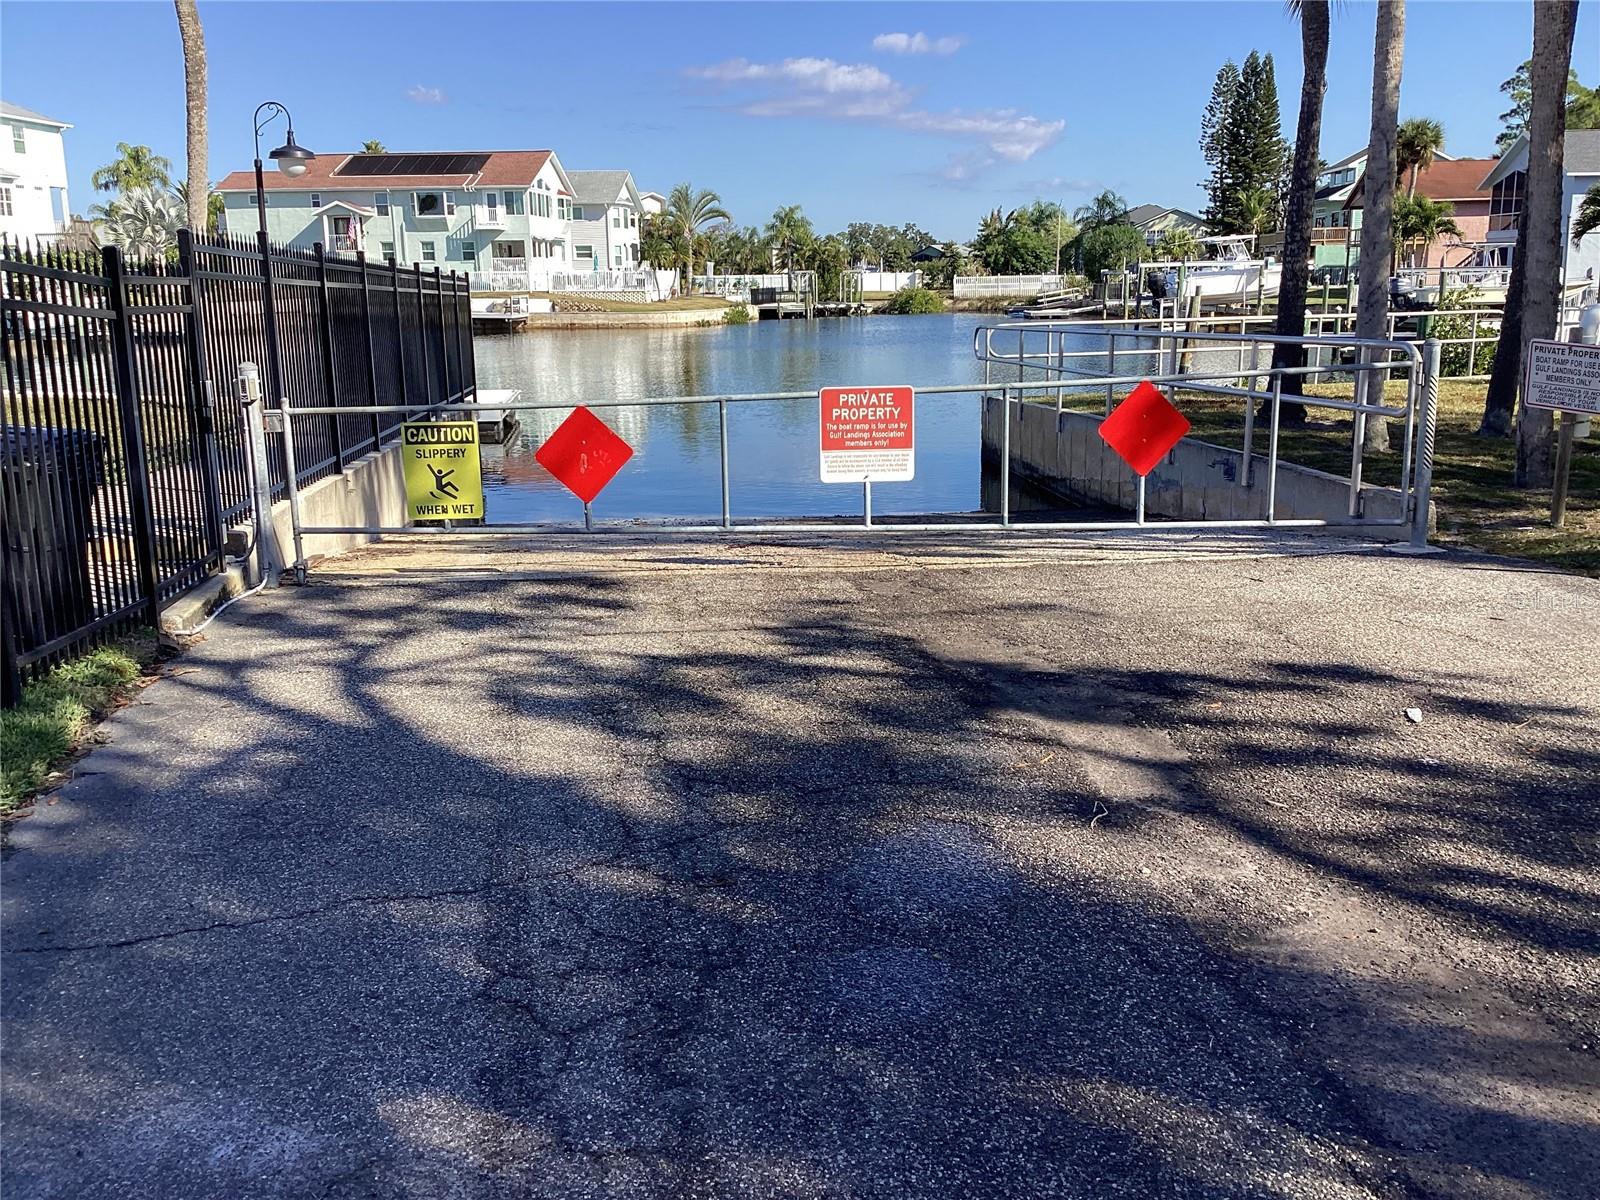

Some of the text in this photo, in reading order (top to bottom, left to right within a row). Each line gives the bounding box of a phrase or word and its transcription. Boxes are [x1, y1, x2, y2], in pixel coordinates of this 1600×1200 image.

[1535, 346, 1600, 360] PRIVATE PROPER
[1535, 356, 1551, 364] BOAT
[1570, 360, 1583, 368] FOR
[1584, 362, 1596, 370] USE
[1535, 364, 1600, 378] GULF LANDINGS ASSO
[1546, 375, 1592, 386] MEMBERS ONLY
[1538, 389, 1582, 398] RESPONSIBLE
[1549, 385, 1582, 394] LANDINGS
[839, 392, 894, 406] PRIVATE
[832, 407, 901, 420] PROPERTY
[900, 422, 908, 430] by
[407, 428, 473, 442] CAUTION
[843, 432, 870, 440] Landings
[416, 448, 466, 459] SLIPPERY
[416, 504, 474, 514] WHEN WET
